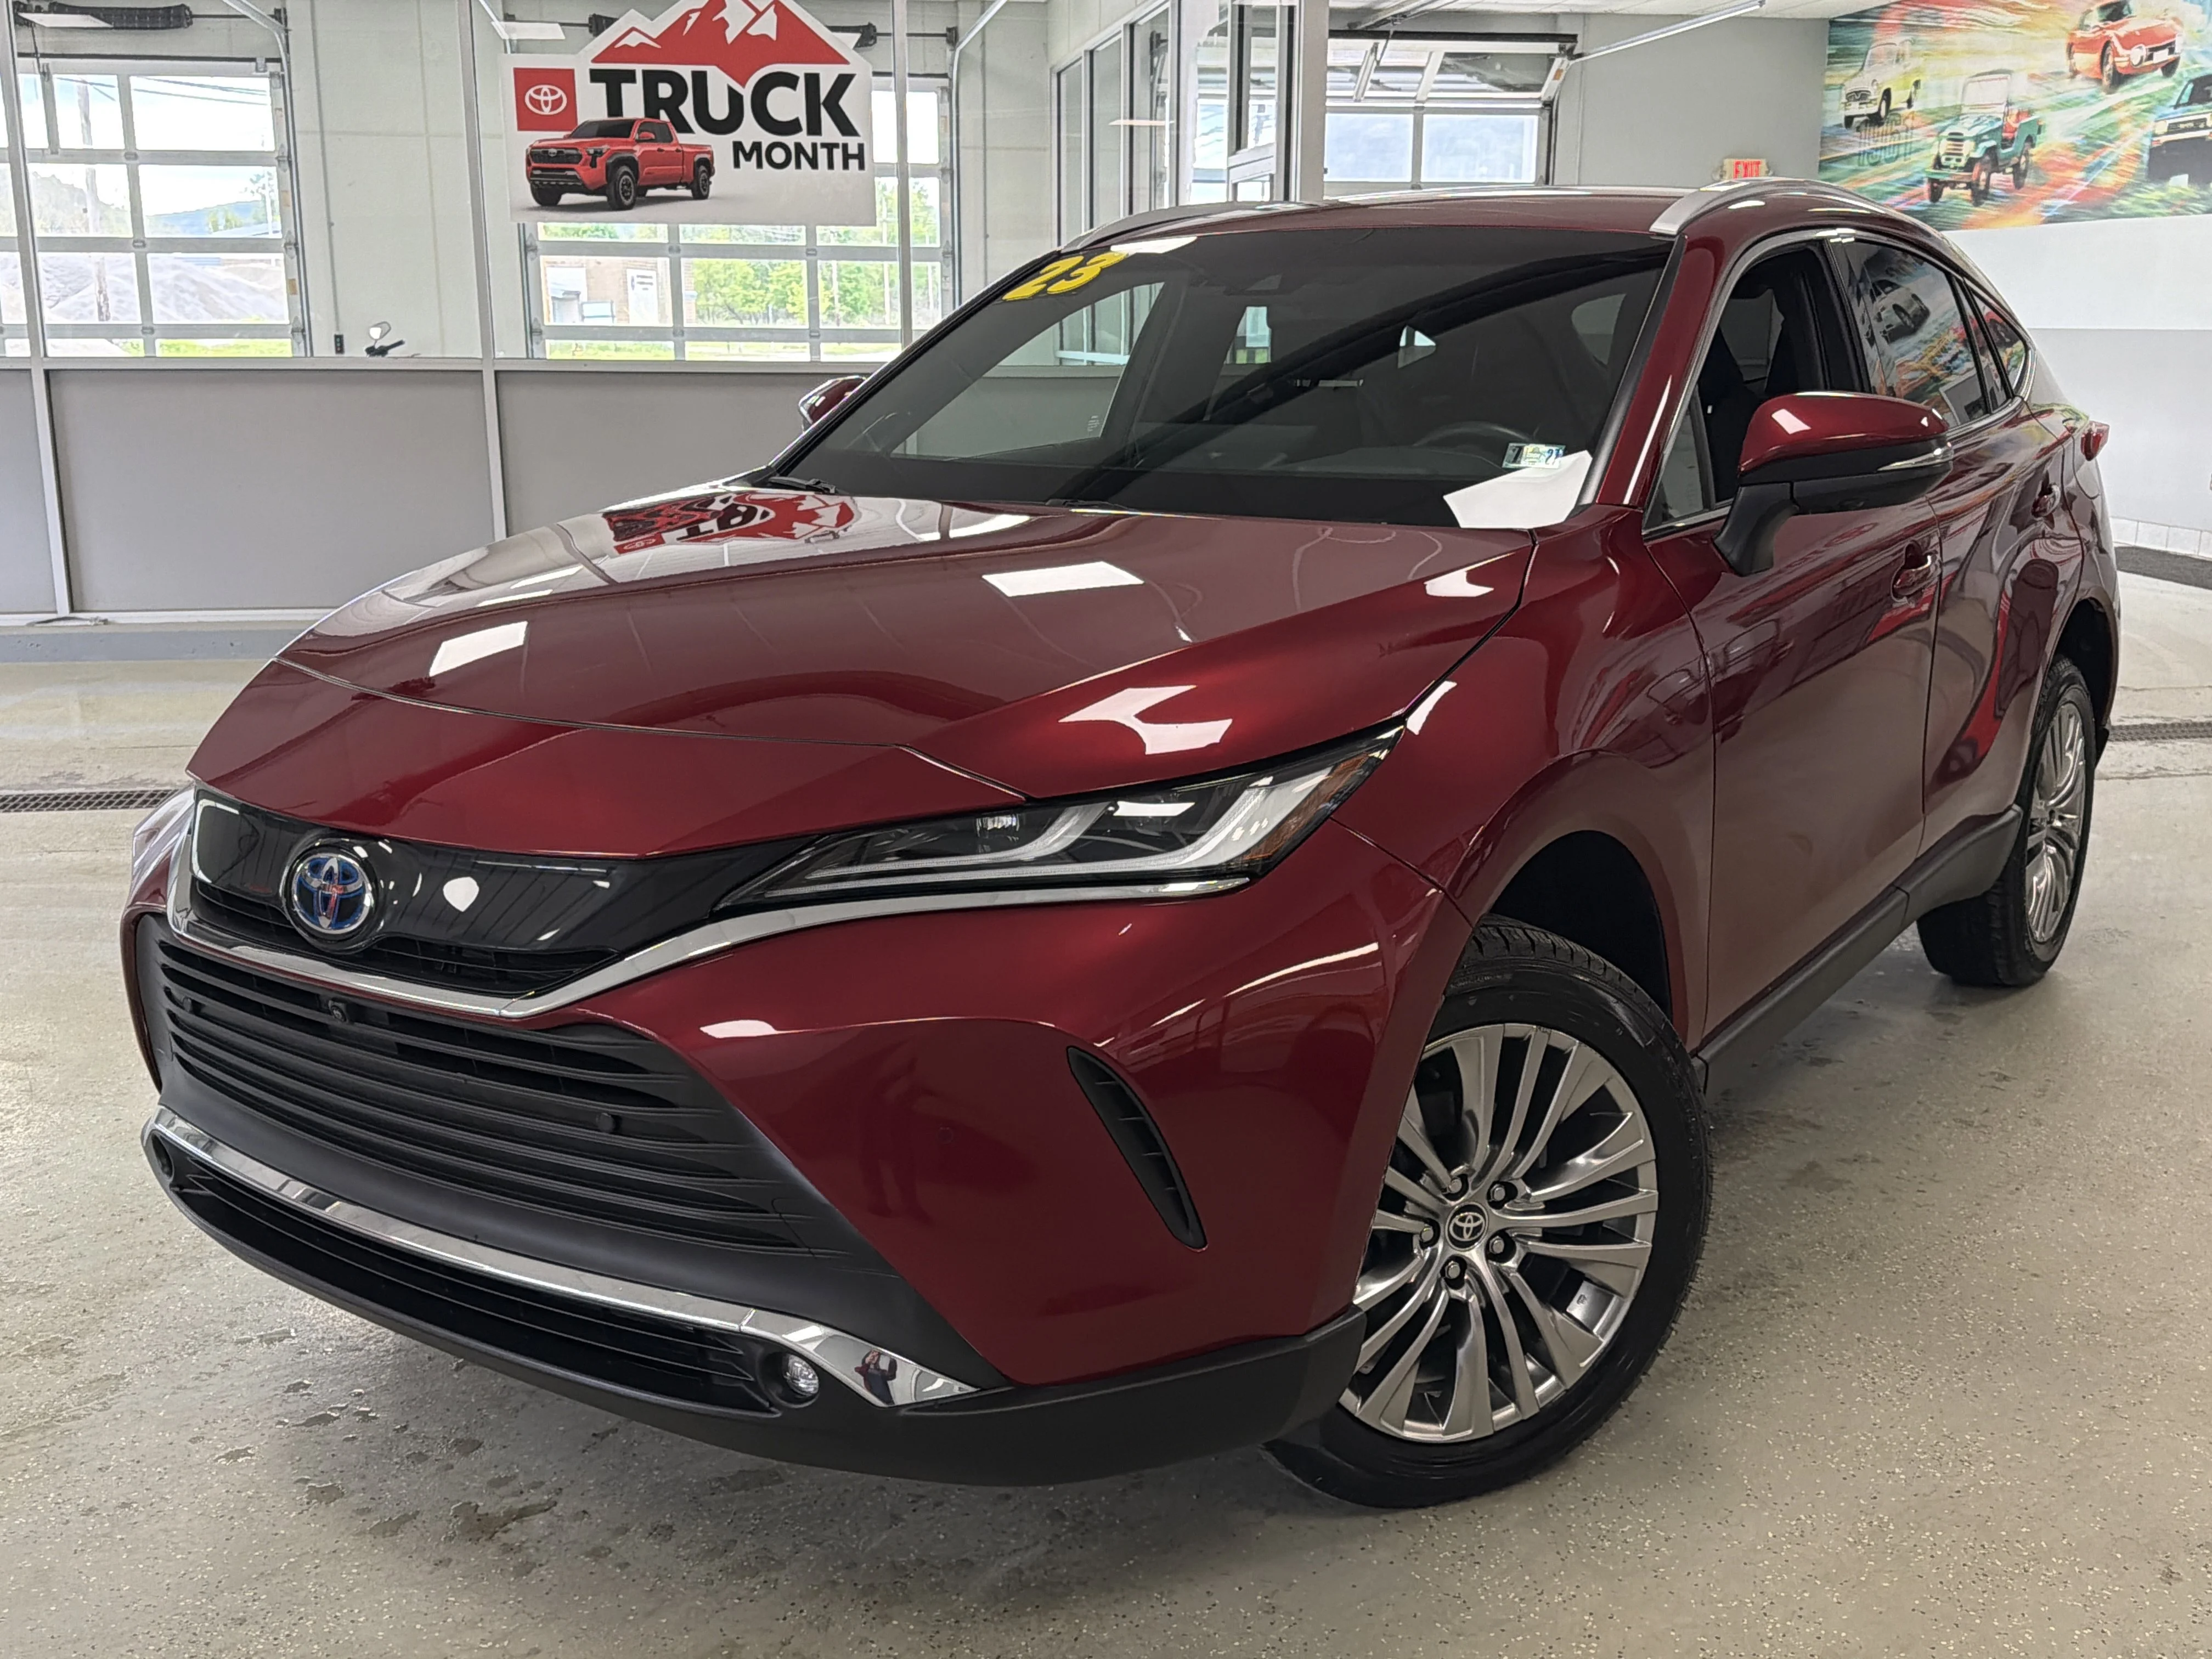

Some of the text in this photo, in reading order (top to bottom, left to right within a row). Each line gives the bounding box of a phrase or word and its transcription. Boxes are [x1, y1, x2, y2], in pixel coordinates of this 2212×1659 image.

[589, 69, 861, 137] TRUCK
[733, 141, 865, 171] MONTH
[1734, 160, 1762, 179] EXIT
[1002, 251, 1129, 301] 23
